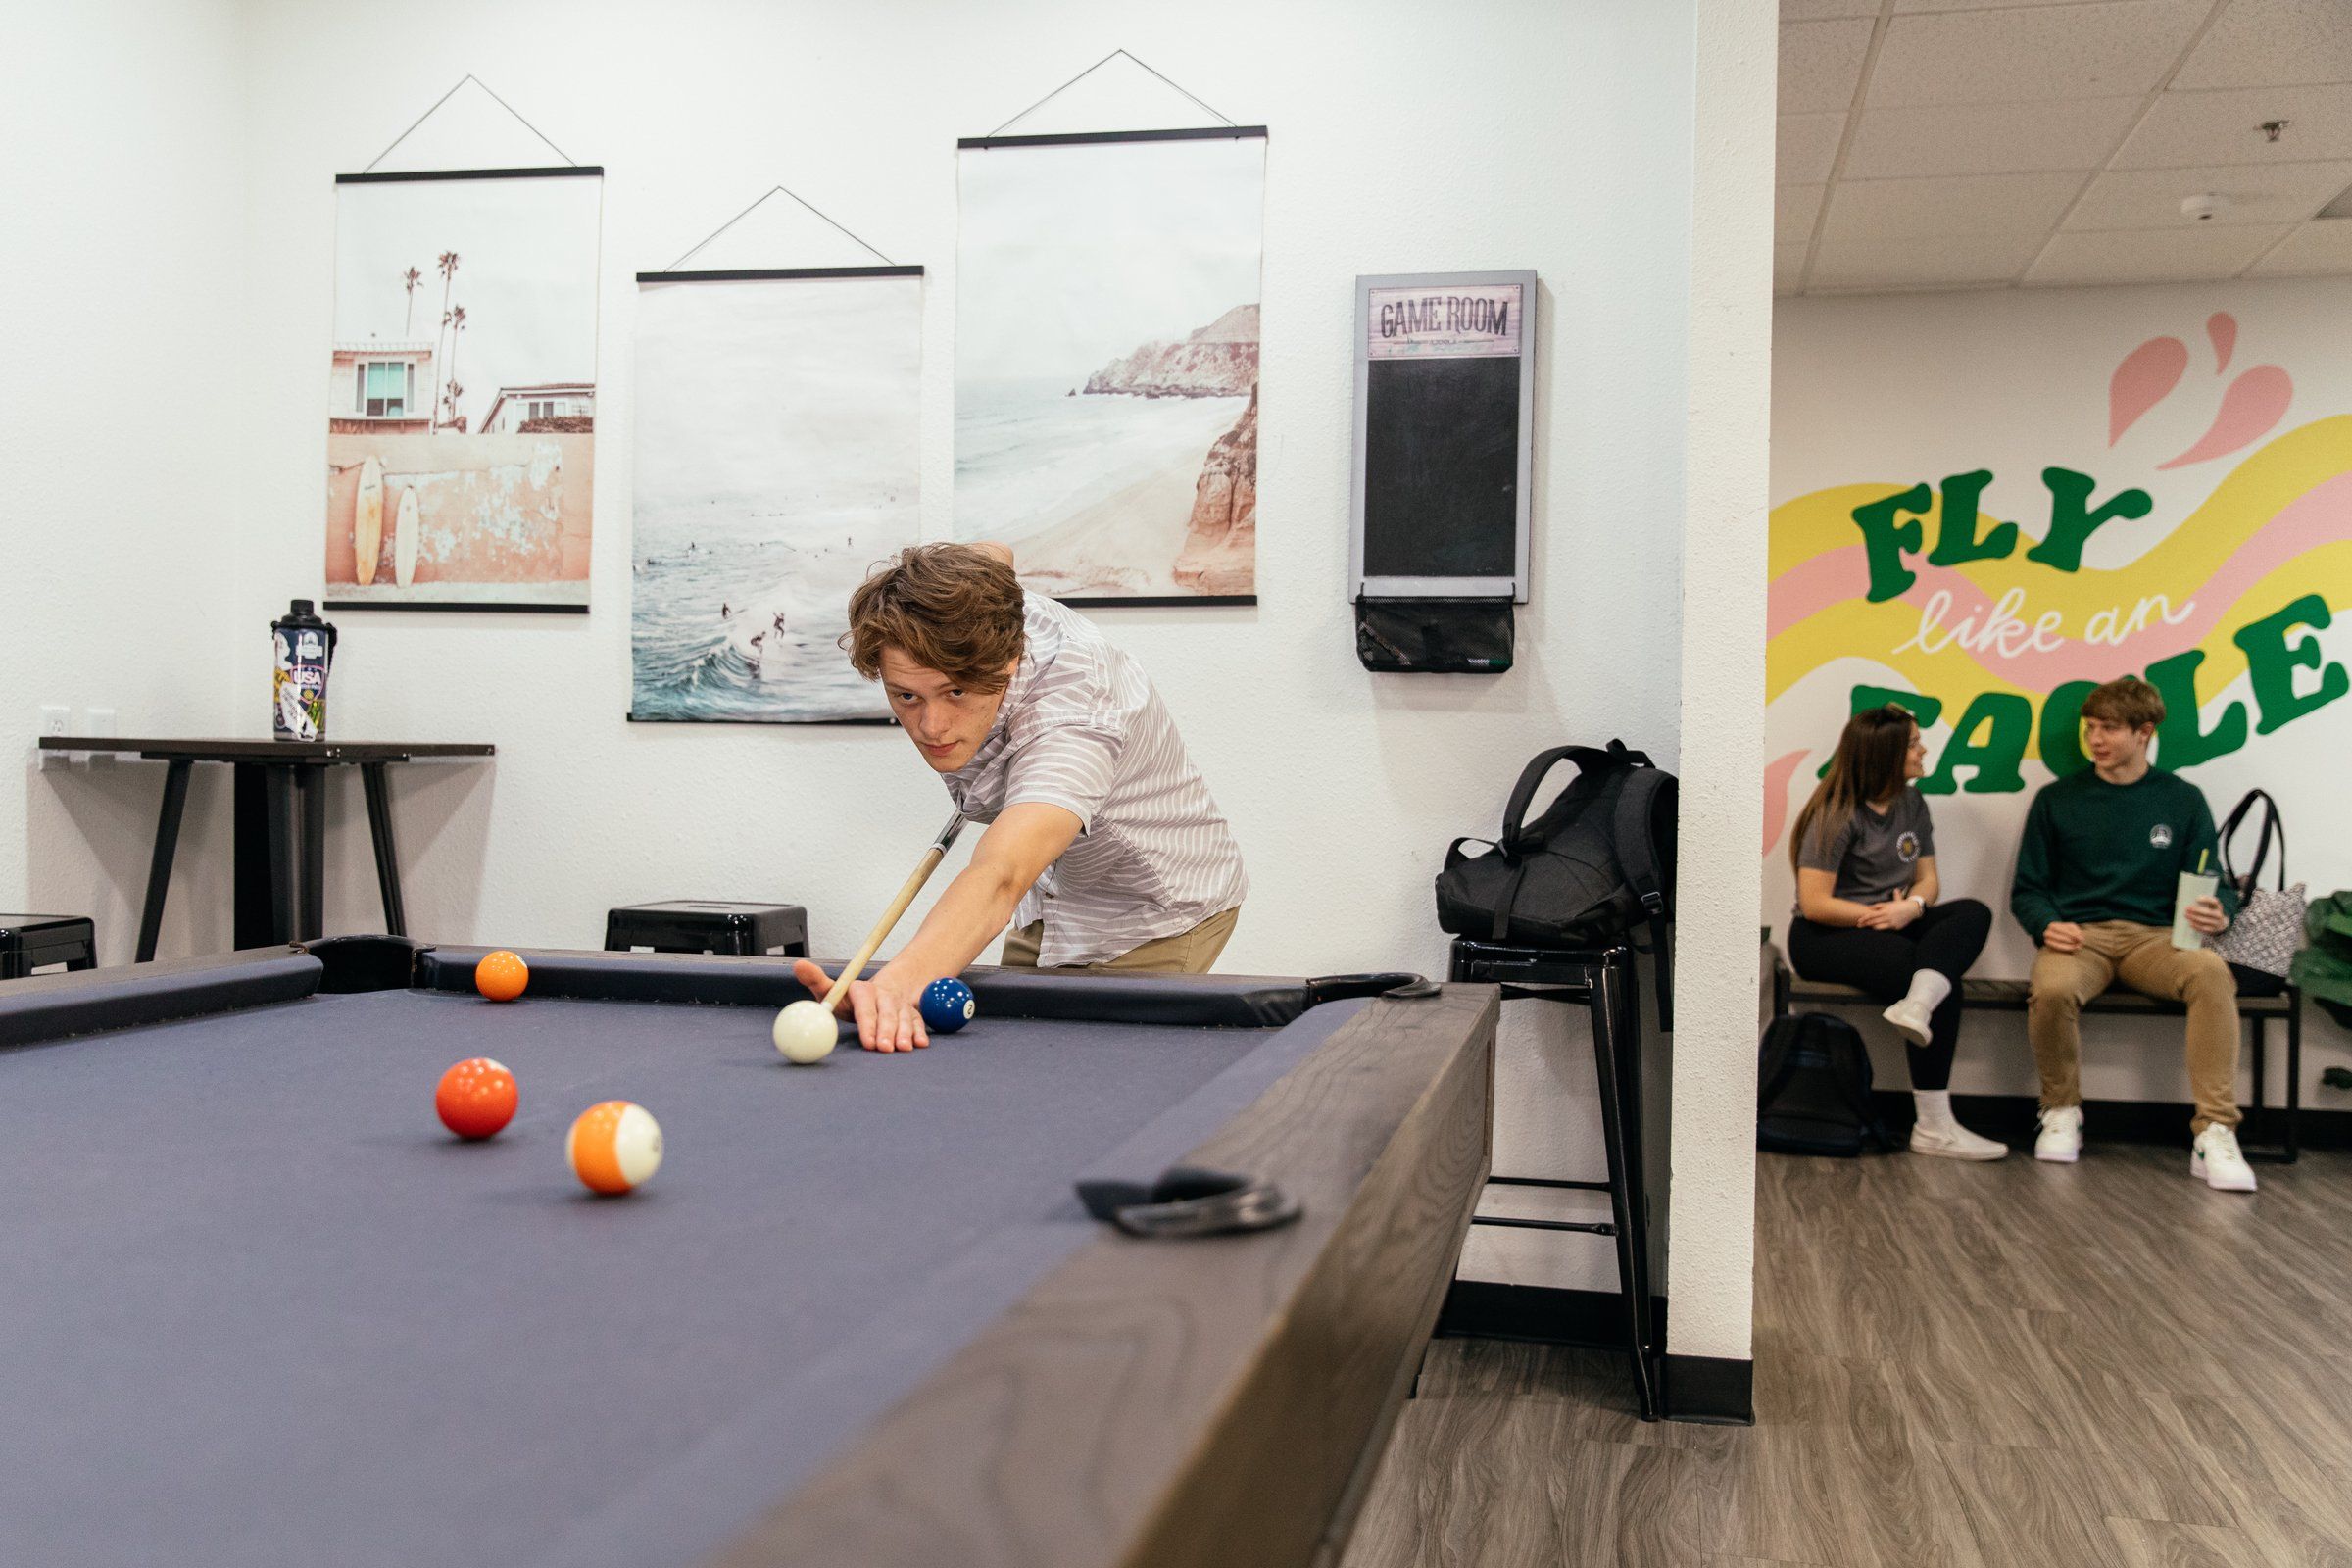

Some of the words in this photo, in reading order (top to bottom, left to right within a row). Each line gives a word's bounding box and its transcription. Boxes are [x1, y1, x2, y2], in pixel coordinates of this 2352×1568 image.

[1381, 297, 1443, 338] GAME
[1446, 296, 1508, 336] ROOM
[1852, 466, 2153, 604] FLY
[1891, 587, 2065, 659] like
[2083, 594, 2196, 647] an
[293, 671, 321, 684] USA
